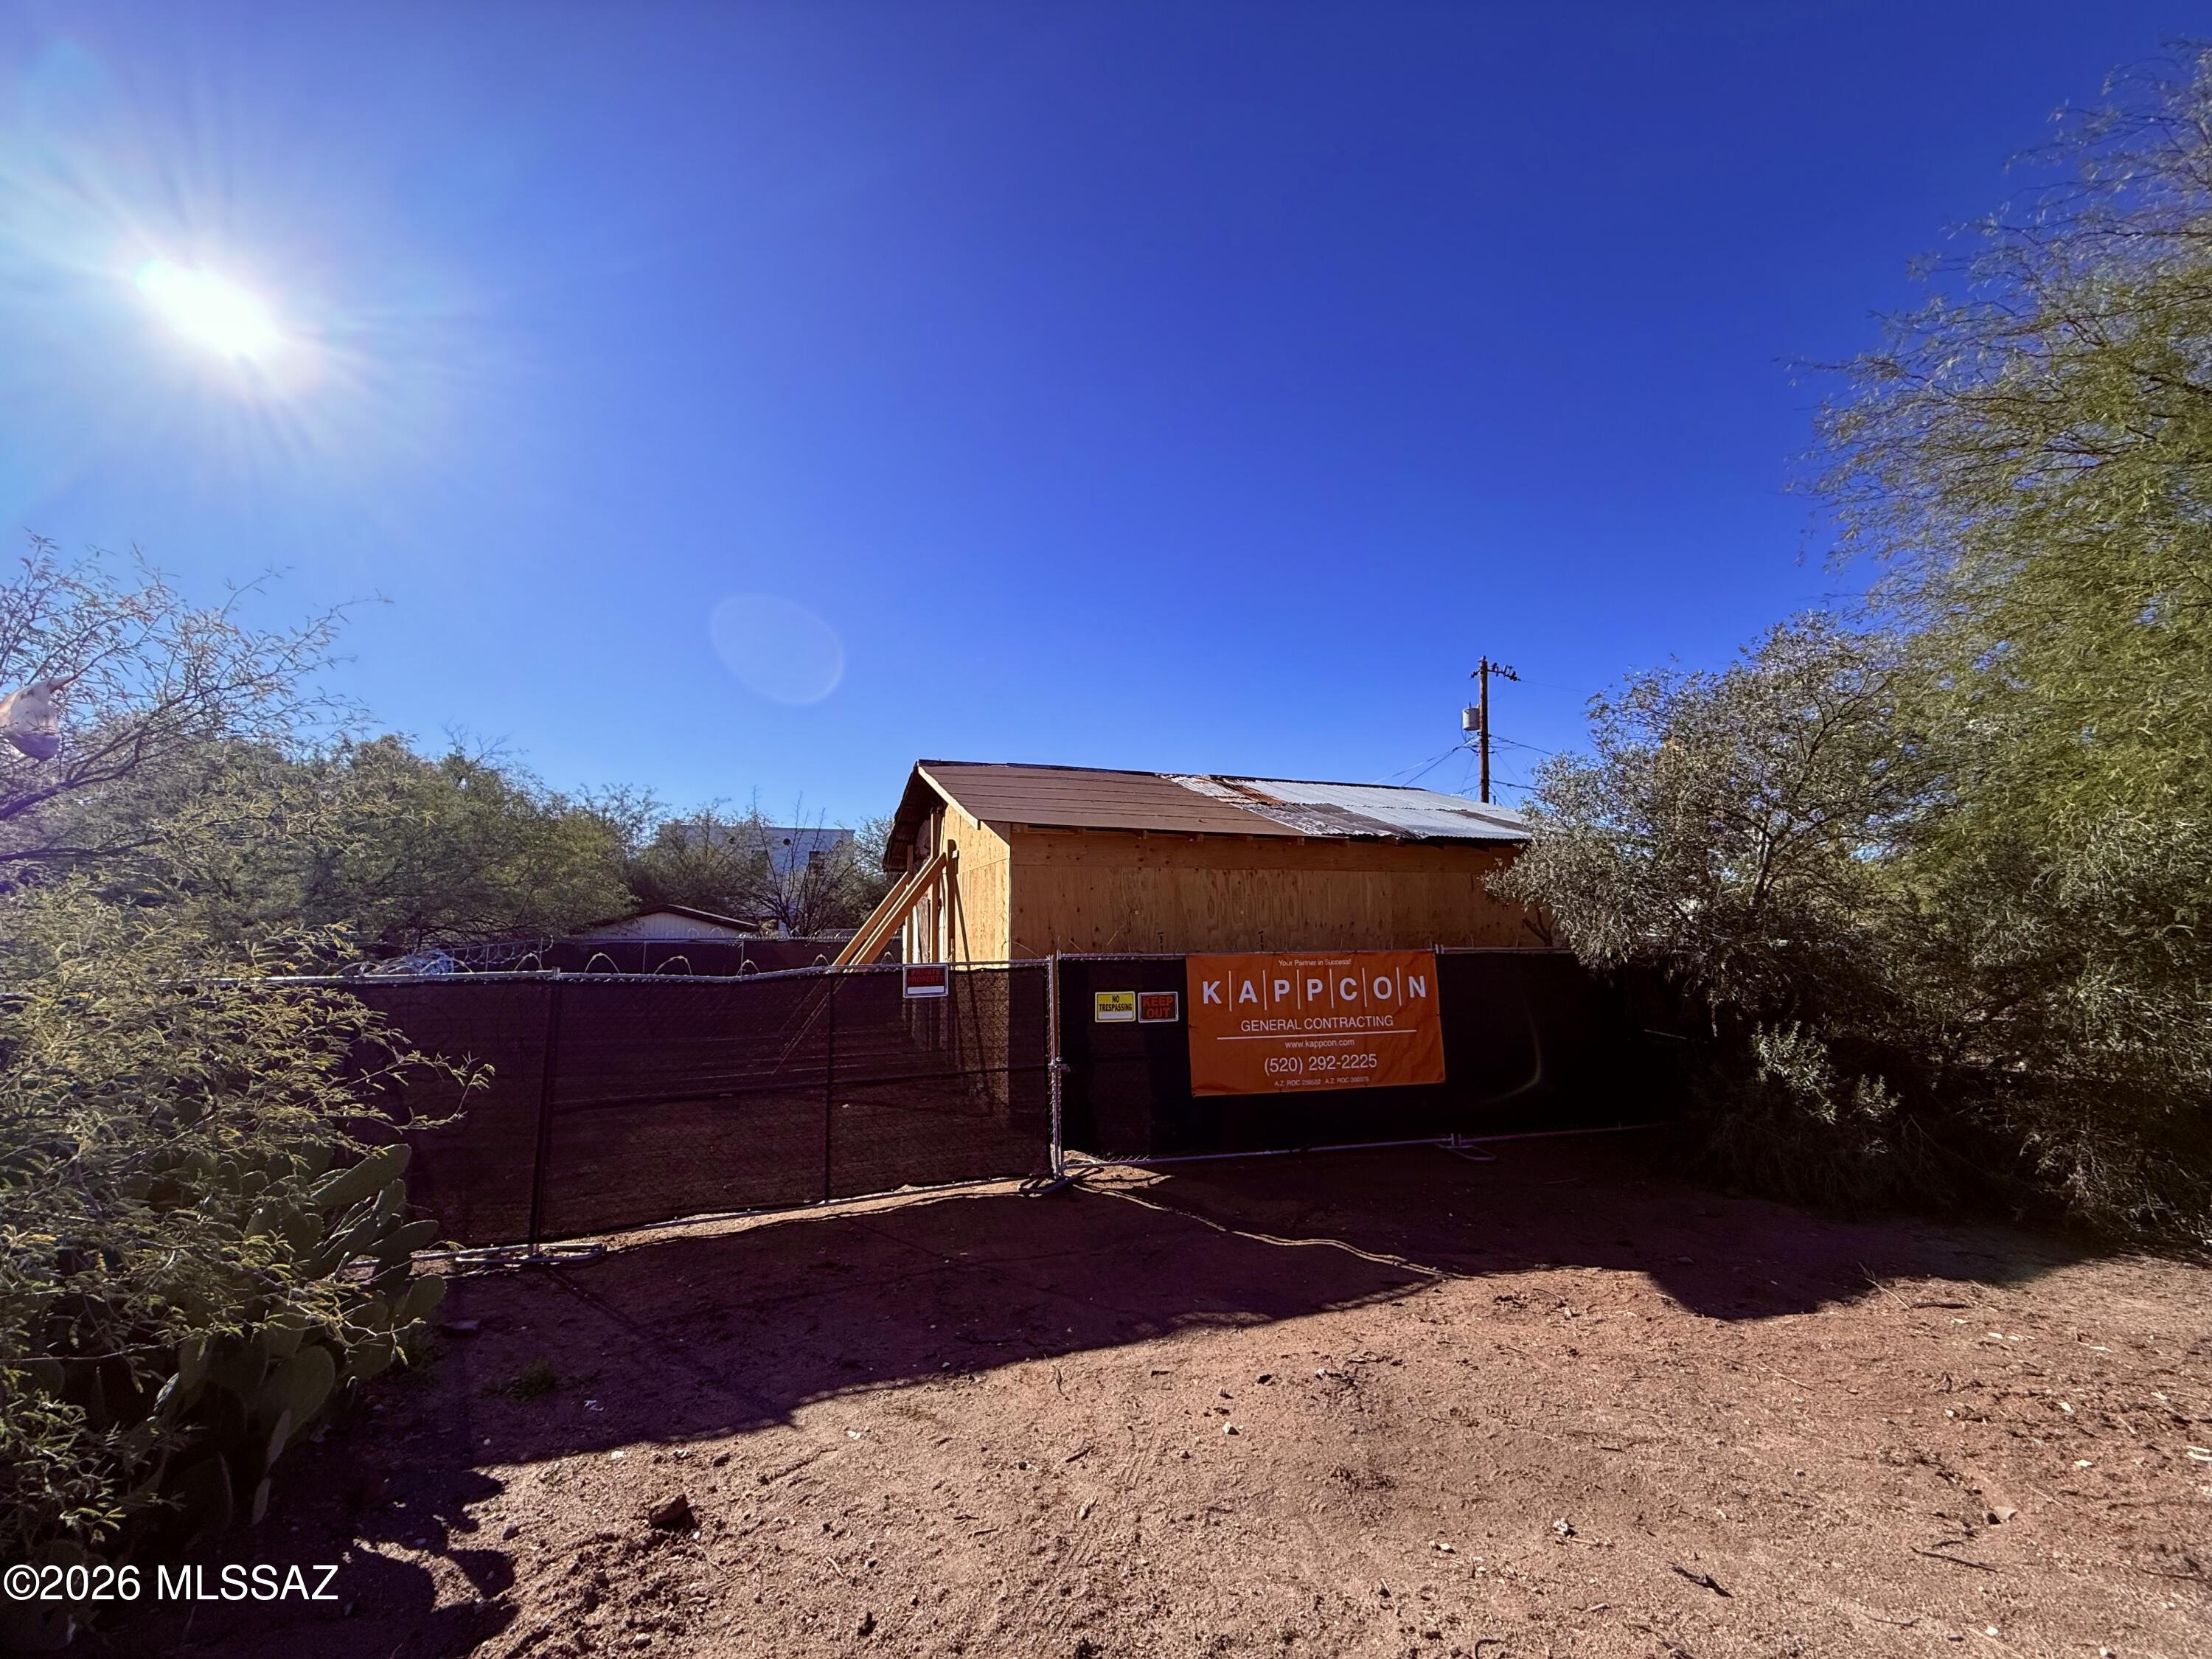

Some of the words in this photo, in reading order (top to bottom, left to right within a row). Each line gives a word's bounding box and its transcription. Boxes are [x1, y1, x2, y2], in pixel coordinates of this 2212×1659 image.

[1112, 995, 1120, 1004] NO
[1143, 996, 1174, 1007] KEEP
[1099, 1004, 1132, 1012] TRESPASSING
[1147, 1008, 1170, 1018] OUT
[1241, 1019, 1301, 1032] GENERAL
[1304, 1015, 1394, 1030] CONTRACTING
[1284, 1038, 1355, 1049] www.kappcon.com
[1265, 1057, 1303, 1076] (520)
[1308, 1054, 1377, 1071] 292-2225
